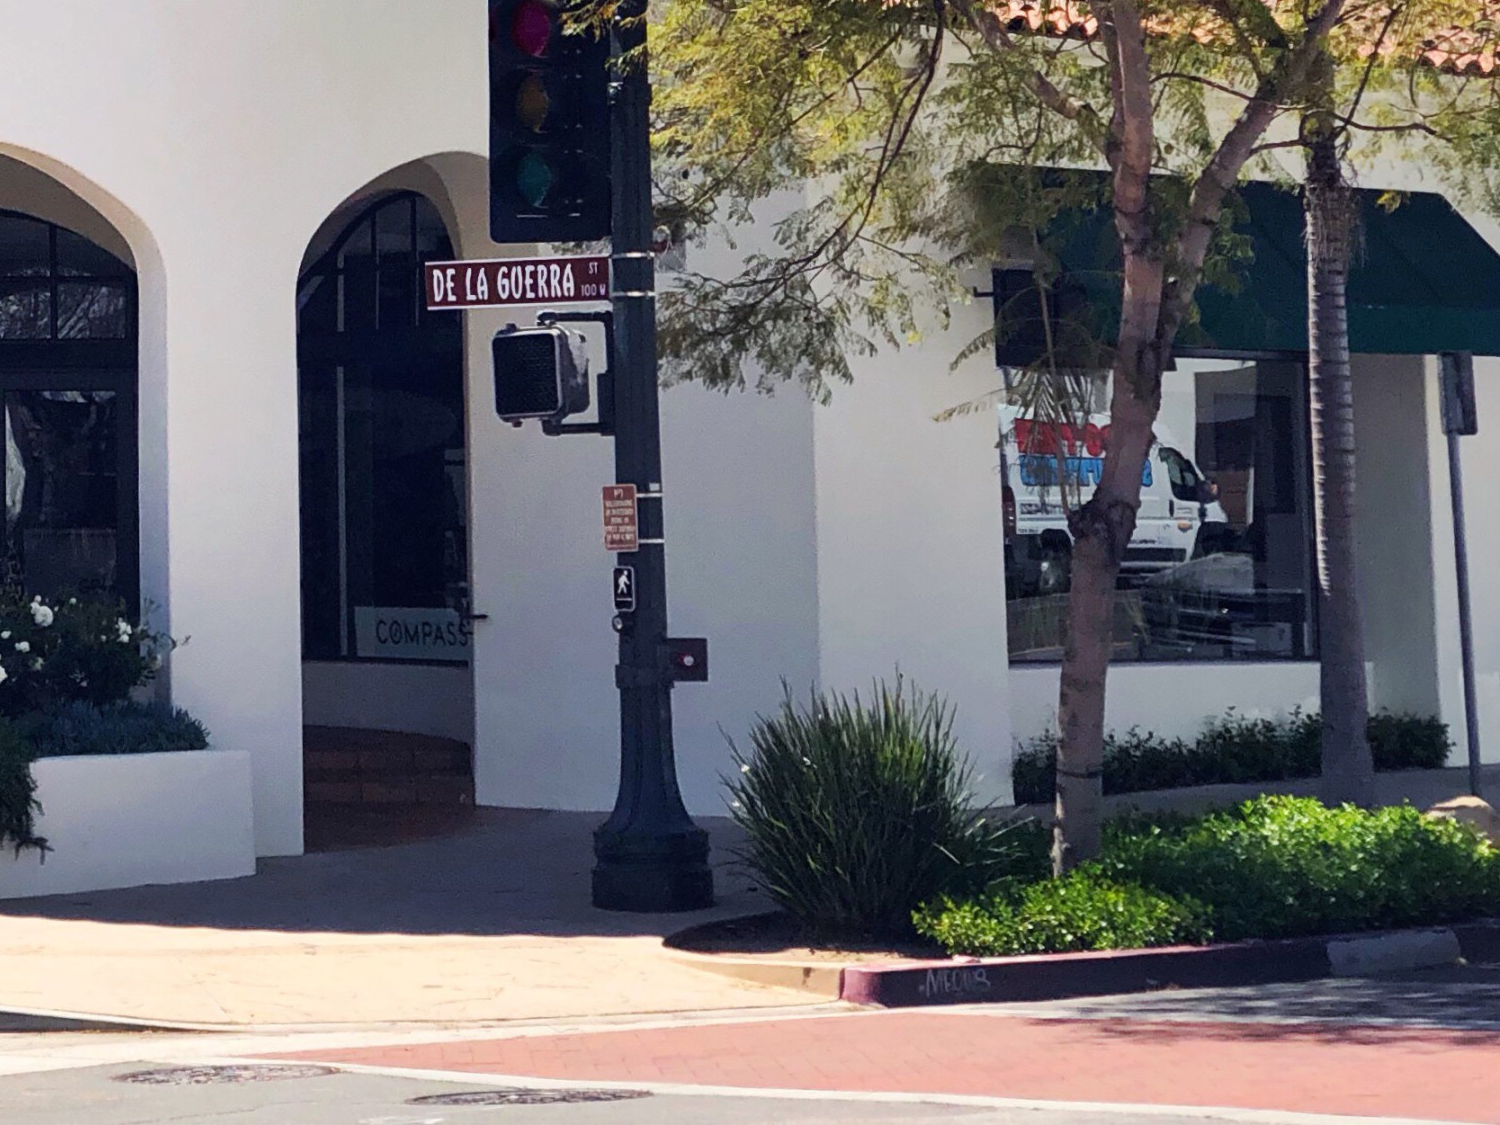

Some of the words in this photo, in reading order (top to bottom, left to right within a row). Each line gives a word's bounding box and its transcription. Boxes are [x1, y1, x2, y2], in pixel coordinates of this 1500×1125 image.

[432, 268, 456, 303] DE
[465, 266, 489, 301] LA
[497, 263, 575, 301] GUERRA
[588, 262, 598, 274] ST
[581, 283, 597, 297] 100
[599, 283, 606, 296] W
[376, 619, 468, 646] COMPASS
